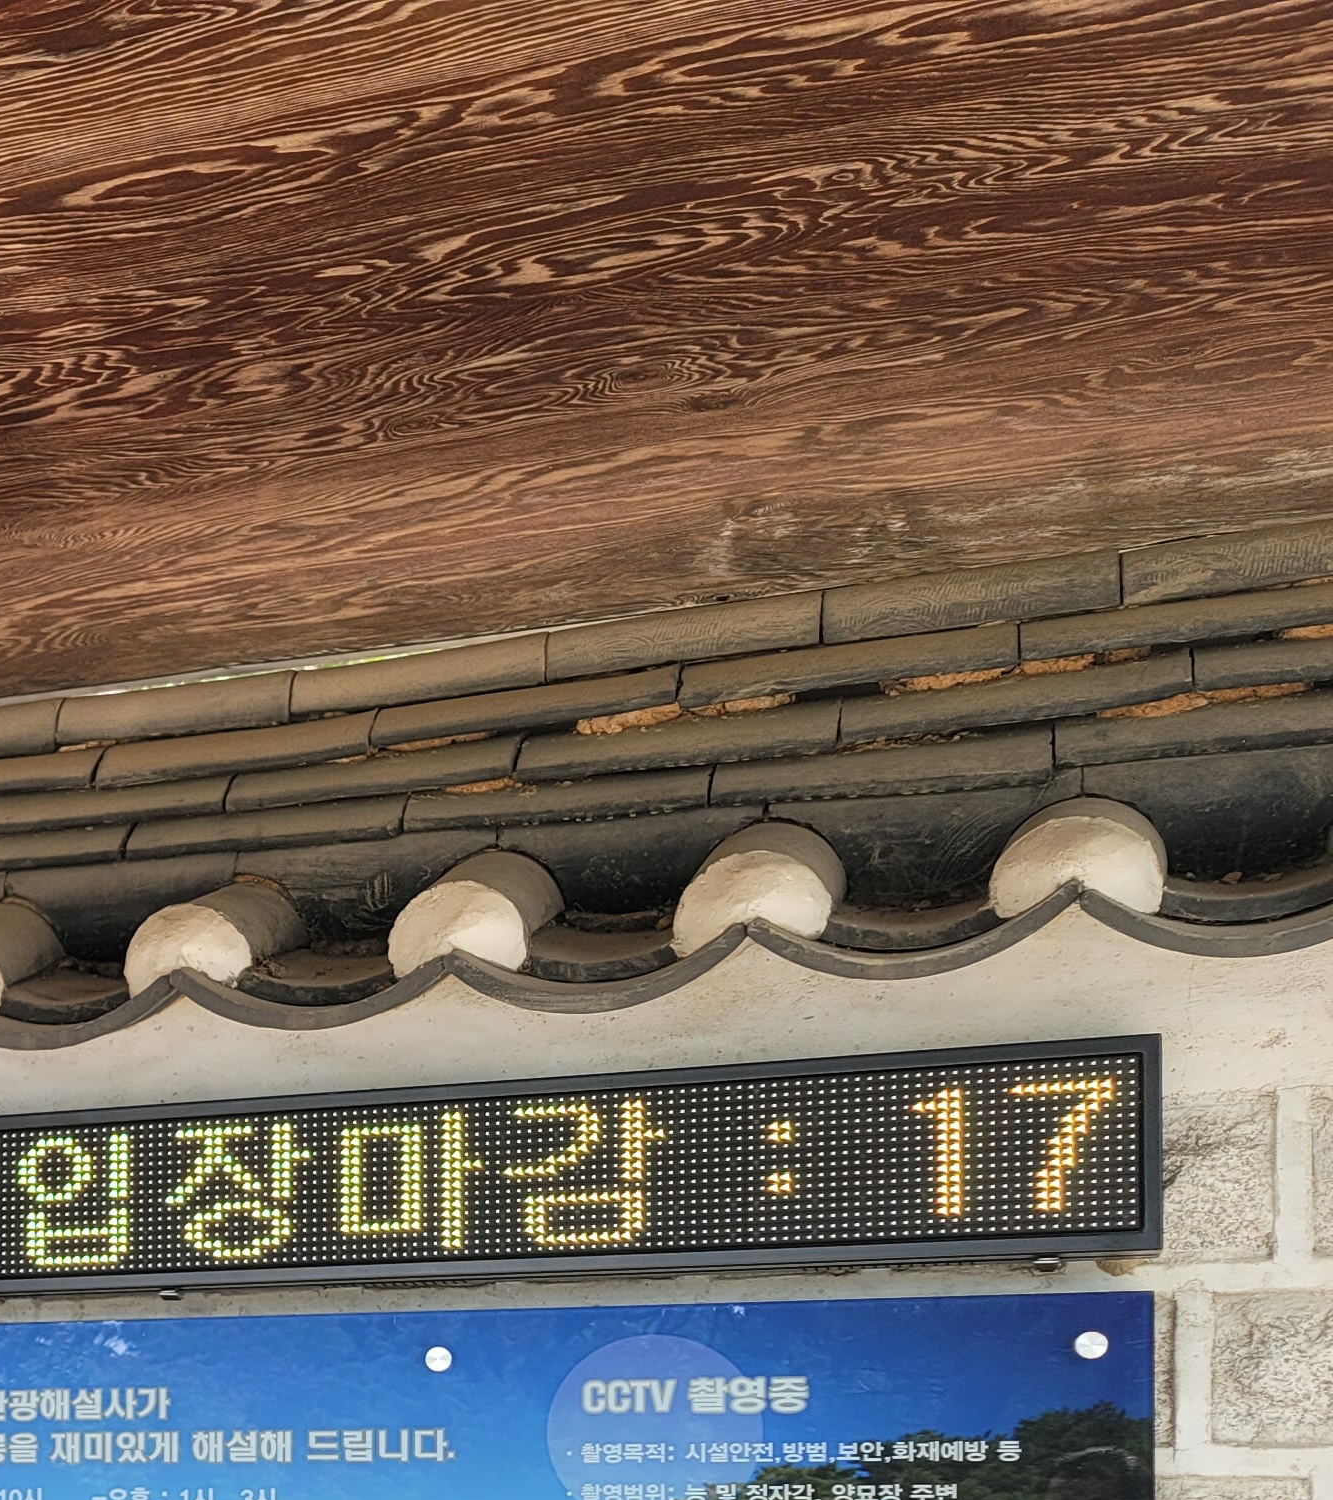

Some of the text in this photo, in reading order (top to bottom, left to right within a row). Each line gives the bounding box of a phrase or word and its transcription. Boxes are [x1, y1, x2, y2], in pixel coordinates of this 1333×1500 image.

[23, 1099, 666, 1265] 입장마감
[912, 1078, 1116, 1217] 17
[582, 1375, 809, 1415] CCTV 촬영중
[50, 1430, 179, 1463] 재미있게
[192, 1430, 293, 1463] 해설해
[306, 1428, 456, 1463] 드립니다.
[580, 1443, 675, 1463] 촬영목적:
[996, 1441, 1022, 1462] 등
